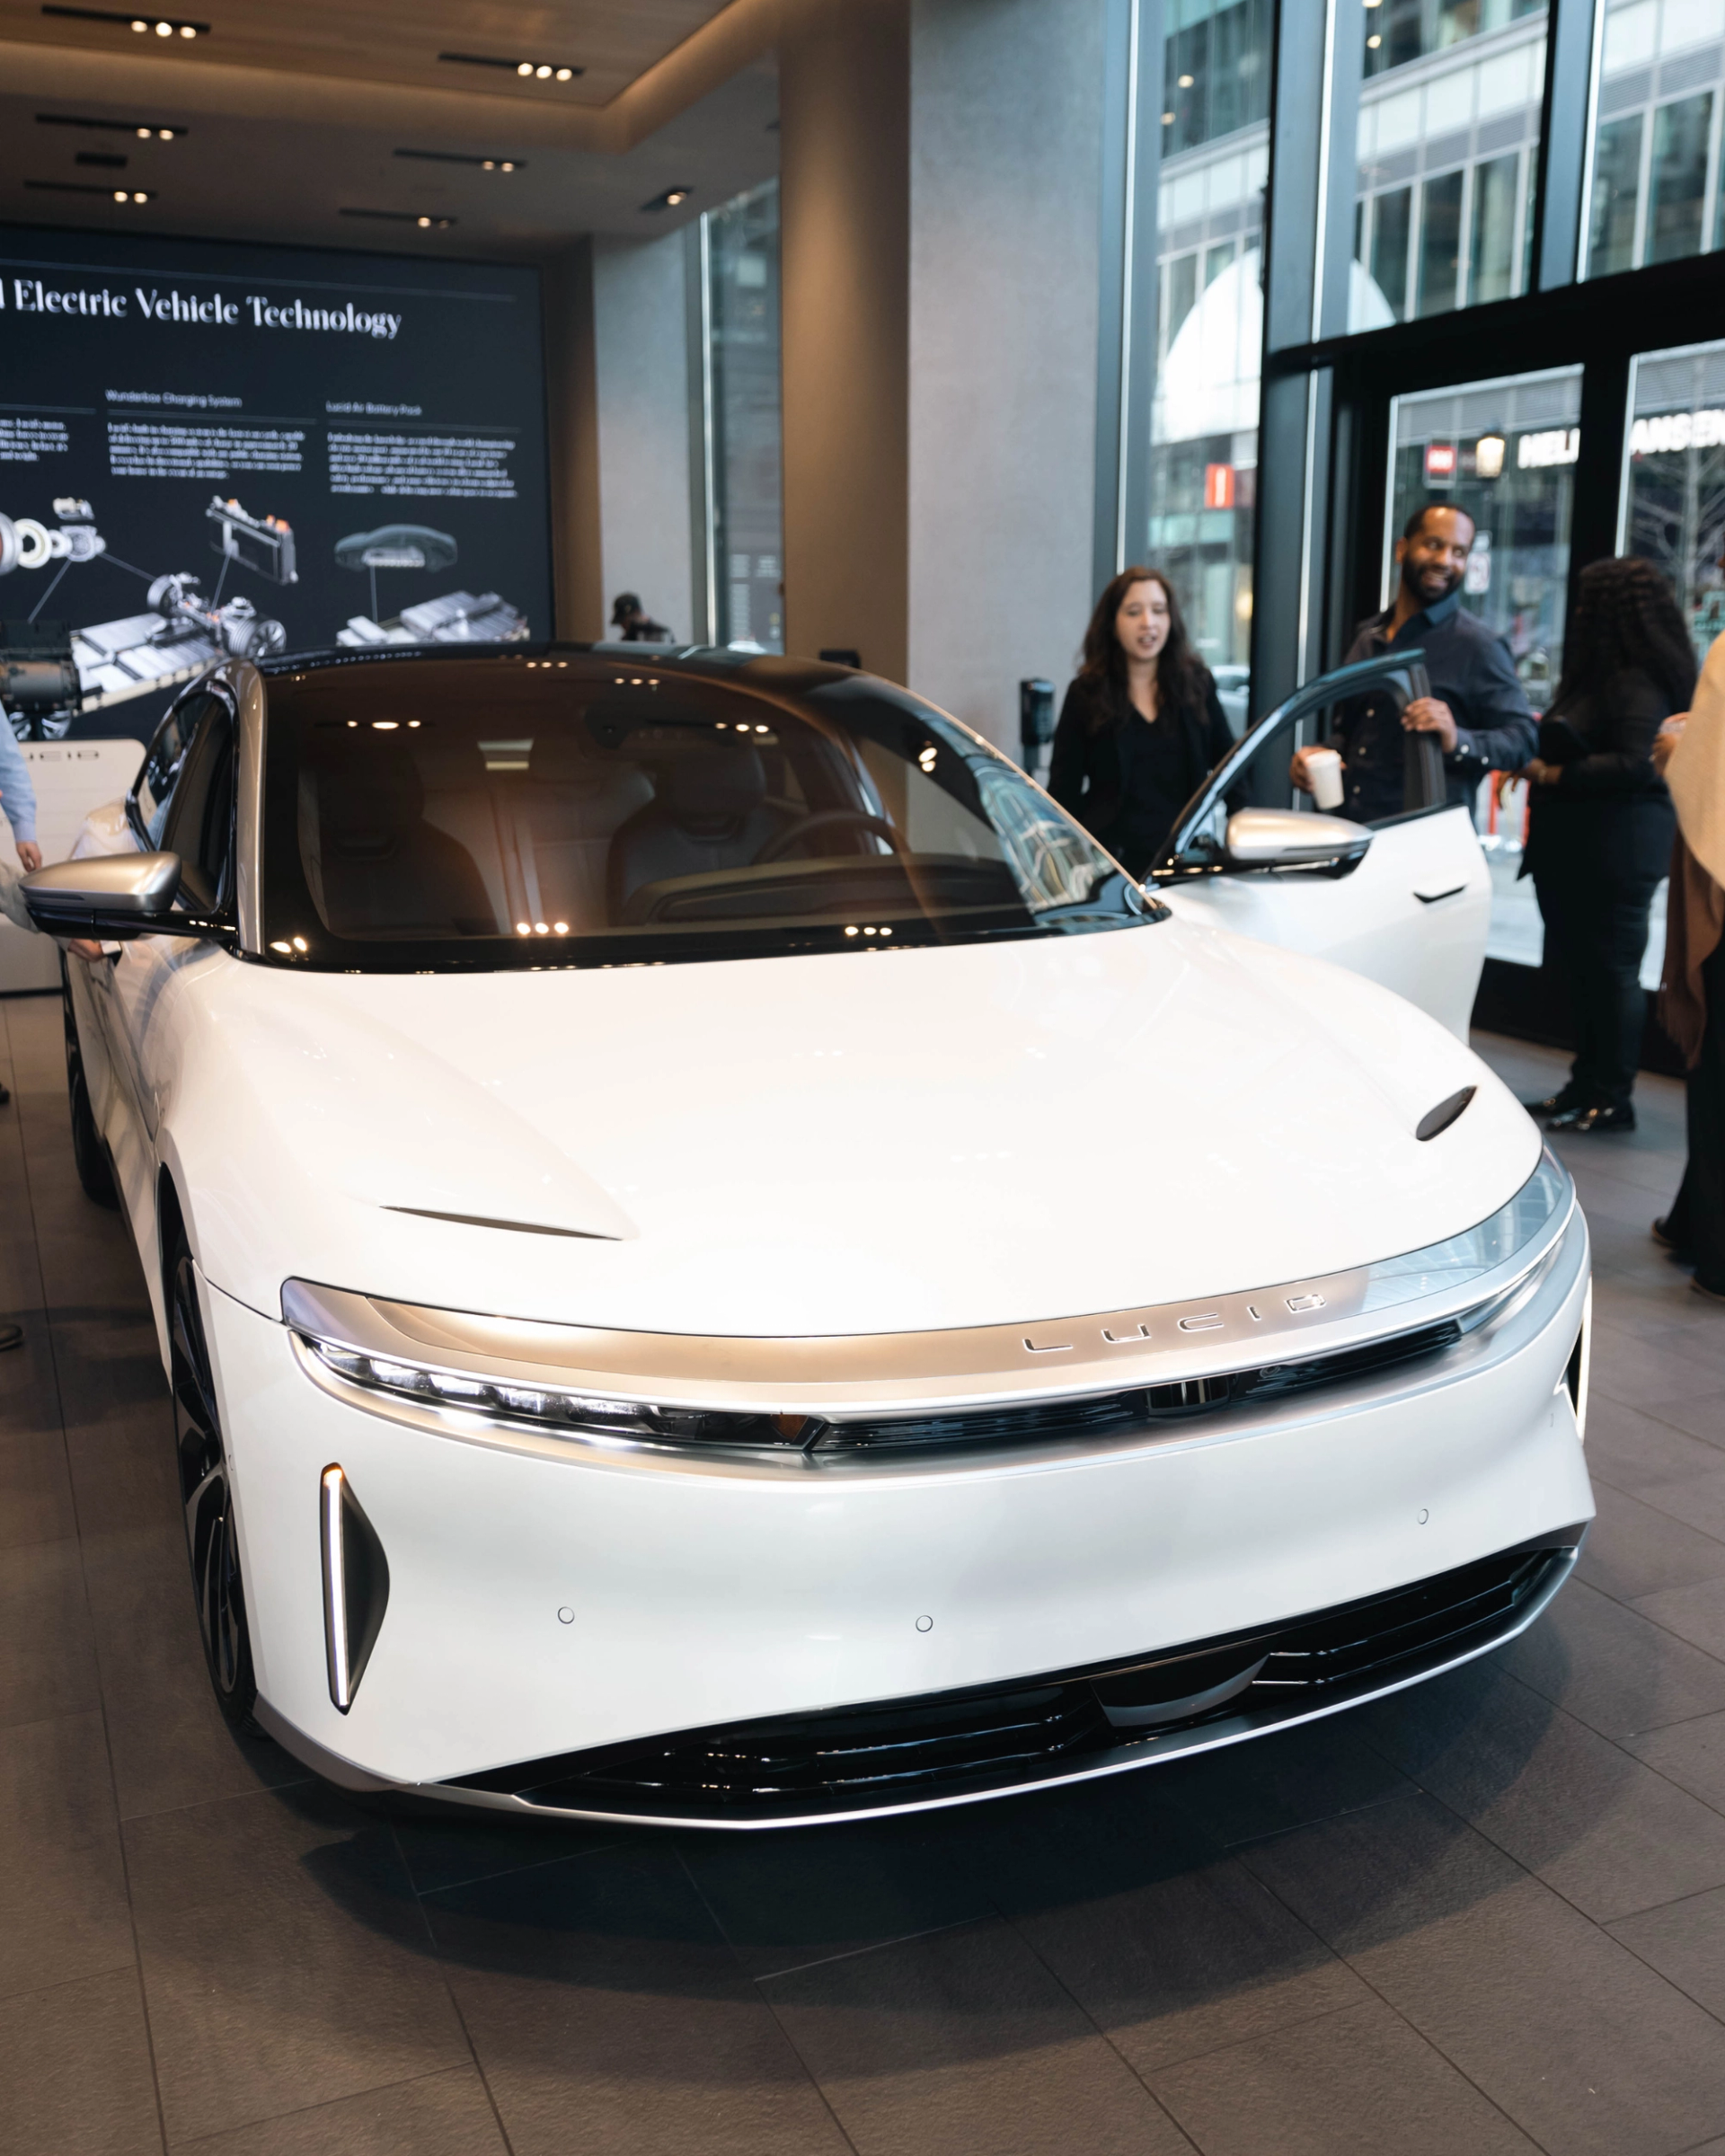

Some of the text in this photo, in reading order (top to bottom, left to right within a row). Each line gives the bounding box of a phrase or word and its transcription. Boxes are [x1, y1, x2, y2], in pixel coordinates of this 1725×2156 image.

[13, 278, 128, 318] Electric
[135, 287, 239, 325] Vehicle
[245, 295, 402, 340] Technology
[162, 392, 207, 408] Charging
[208, 393, 243, 409] System
[1022, 1294, 1327, 1354] LUCID
